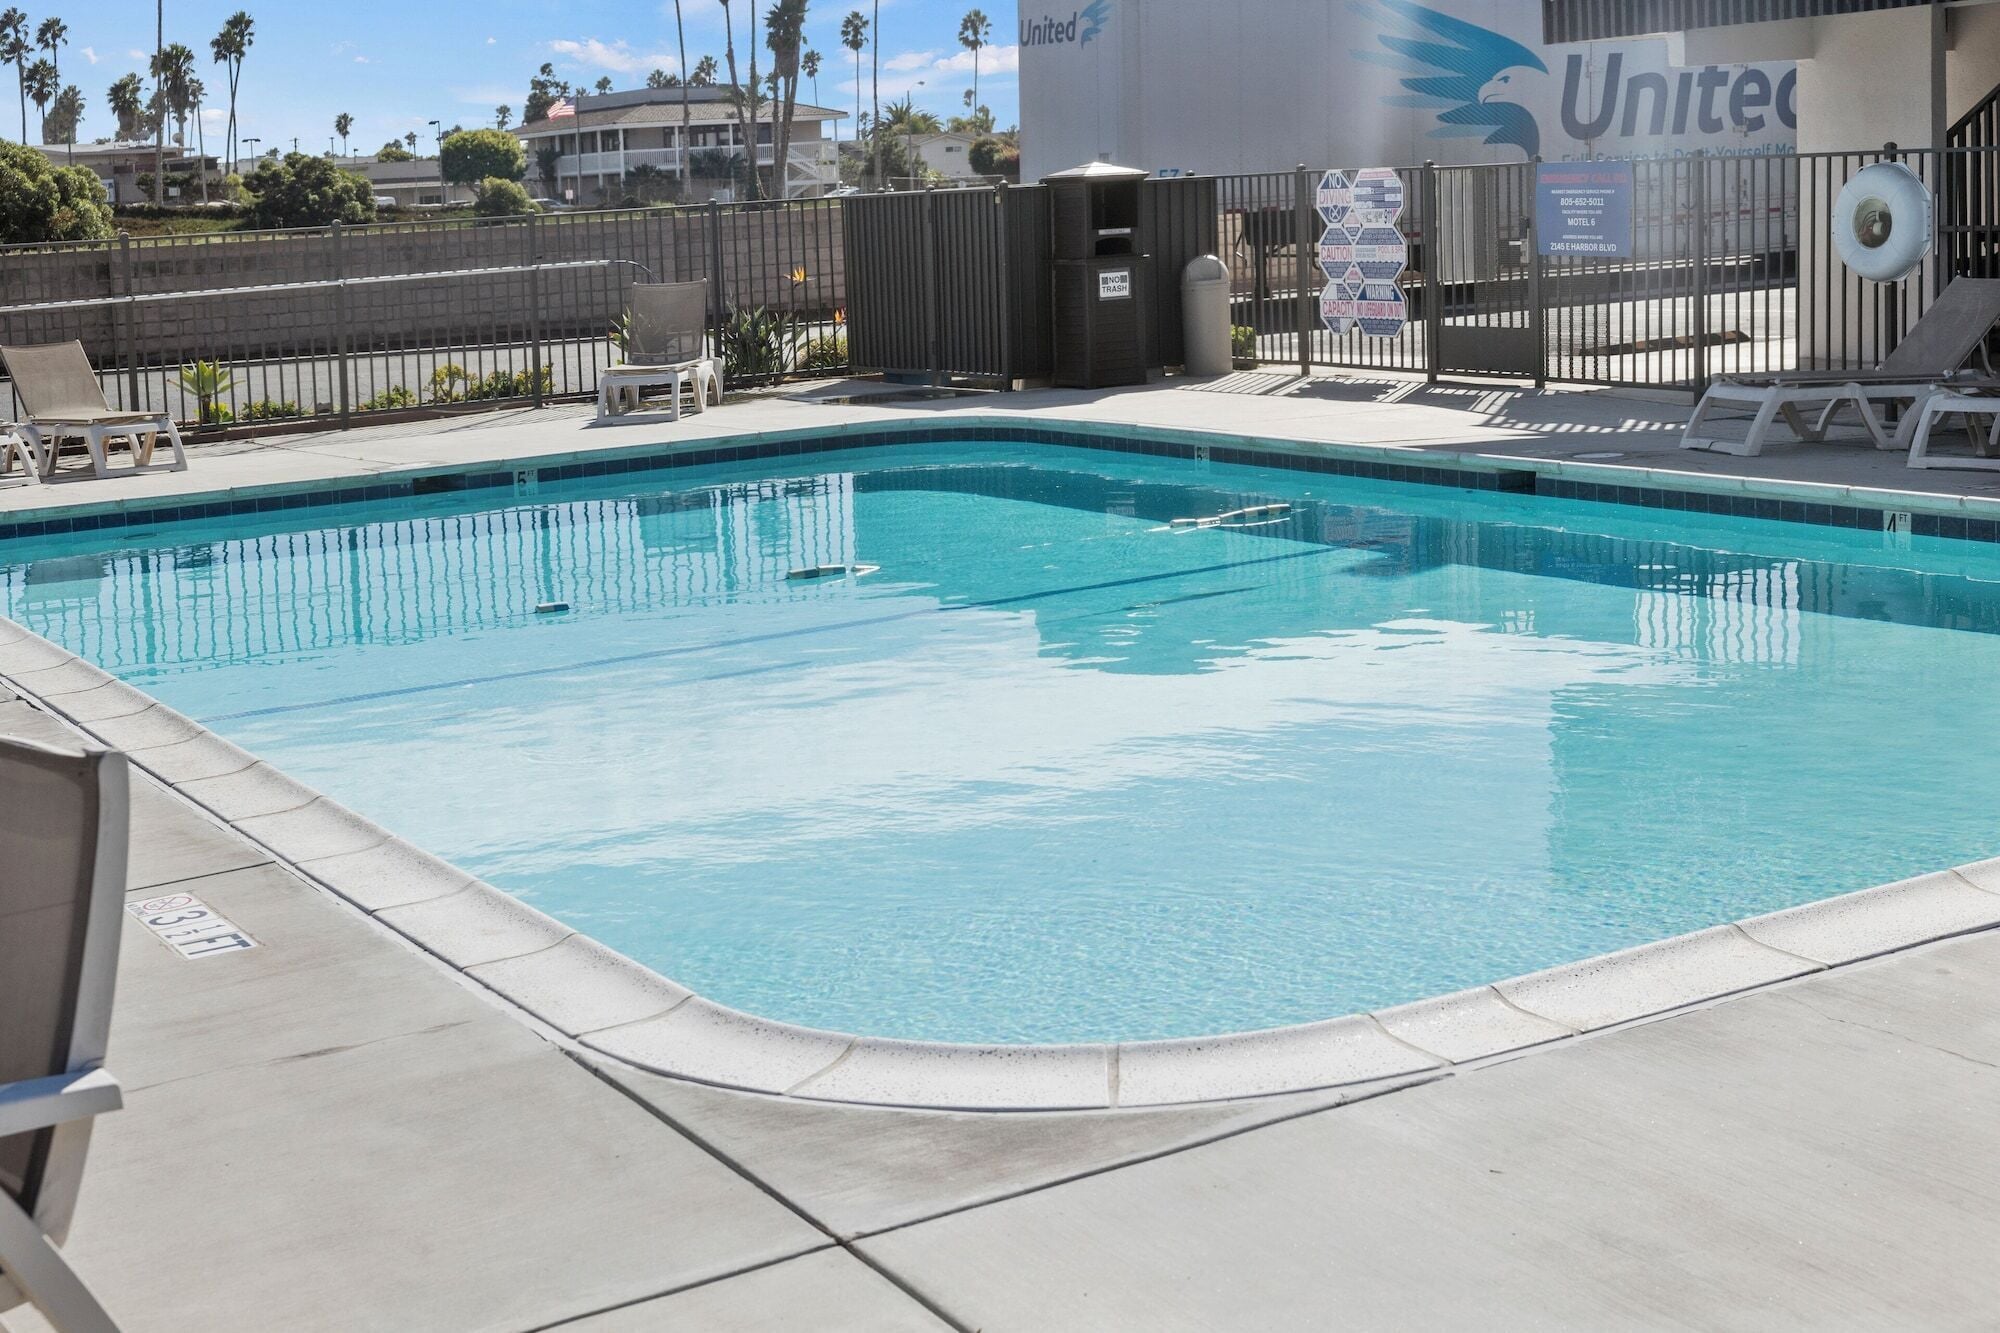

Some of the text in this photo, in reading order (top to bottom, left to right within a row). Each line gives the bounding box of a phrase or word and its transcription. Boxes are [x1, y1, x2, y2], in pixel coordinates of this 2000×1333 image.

[1019, 12, 1076, 47] United
[1328, 173, 1342, 188] NO
[1320, 189, 1351, 204] DIVING
[1560, 198, 1604, 206] 805-652-5011
[1567, 218, 1596, 226] MOTEL 6
[1321, 247, 1353, 260] CAUTION
[1550, 242, 1617, 252] 2145 E HARBOR BLVD
[1108, 276, 1121, 284] NO
[1102, 285, 1127, 293] TRASH
[1364, 284, 1395, 300] WARNING
[1322, 301, 1354, 316] CAPACITY
[1356, 302, 1363, 316] NO
[1363, 302, 1386, 317] LIFEGUARD
[1899, 514, 1908, 522] FT
[148, 910, 208, 926] 3
[178, 933, 251, 955] FT
